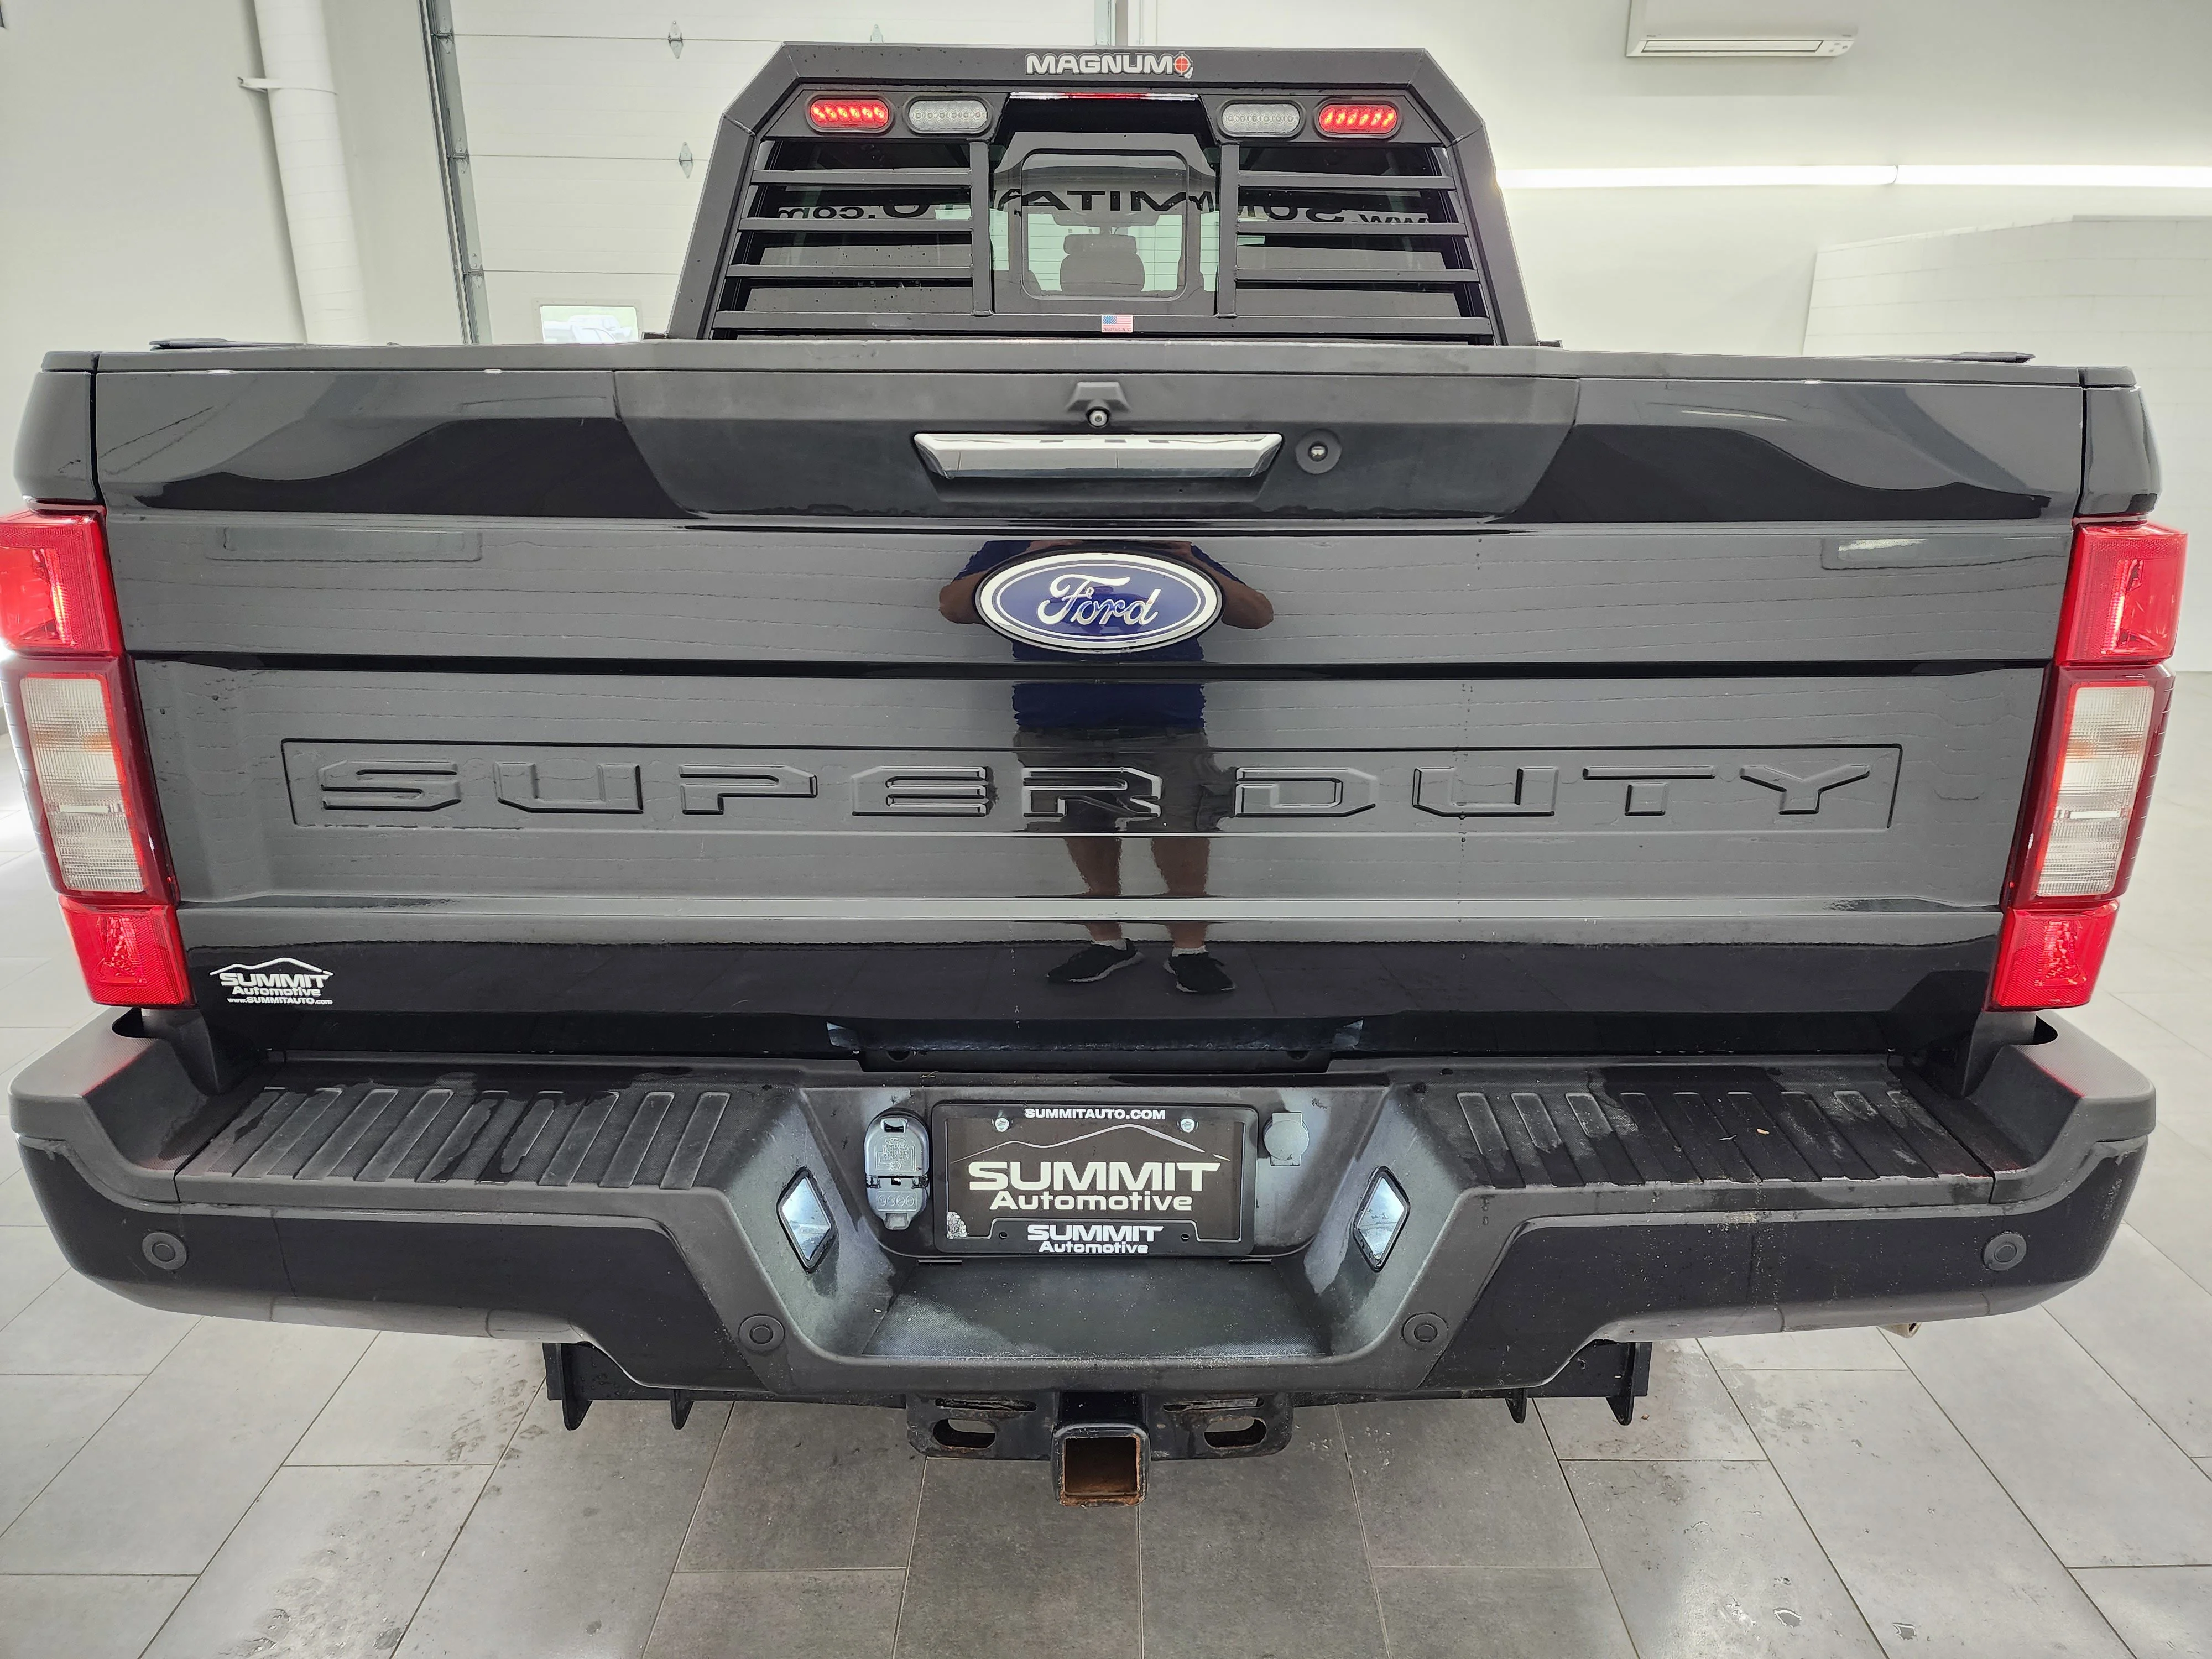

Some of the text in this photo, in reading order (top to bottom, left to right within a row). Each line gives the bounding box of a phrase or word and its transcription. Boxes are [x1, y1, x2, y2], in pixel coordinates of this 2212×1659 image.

[1026, 54, 1173, 74] MAGNUM
[1037, 573, 1161, 625] Ford
[319, 760, 1871, 818] SUPER DUTY
[219, 973, 329, 988] SUMMIT
[232, 985, 321, 997] Automotive
[227, 997, 333, 1005] www.SUMMITAUTO.com
[1025, 1108, 1166, 1120] SUMMITAUTO.COM
[968, 1161, 1221, 1191] SUMMIT
[989, 1190, 1193, 1211] Automotive
[1027, 1224, 1164, 1242] SUMMIT
[1038, 1241, 1149, 1254] Automotive
